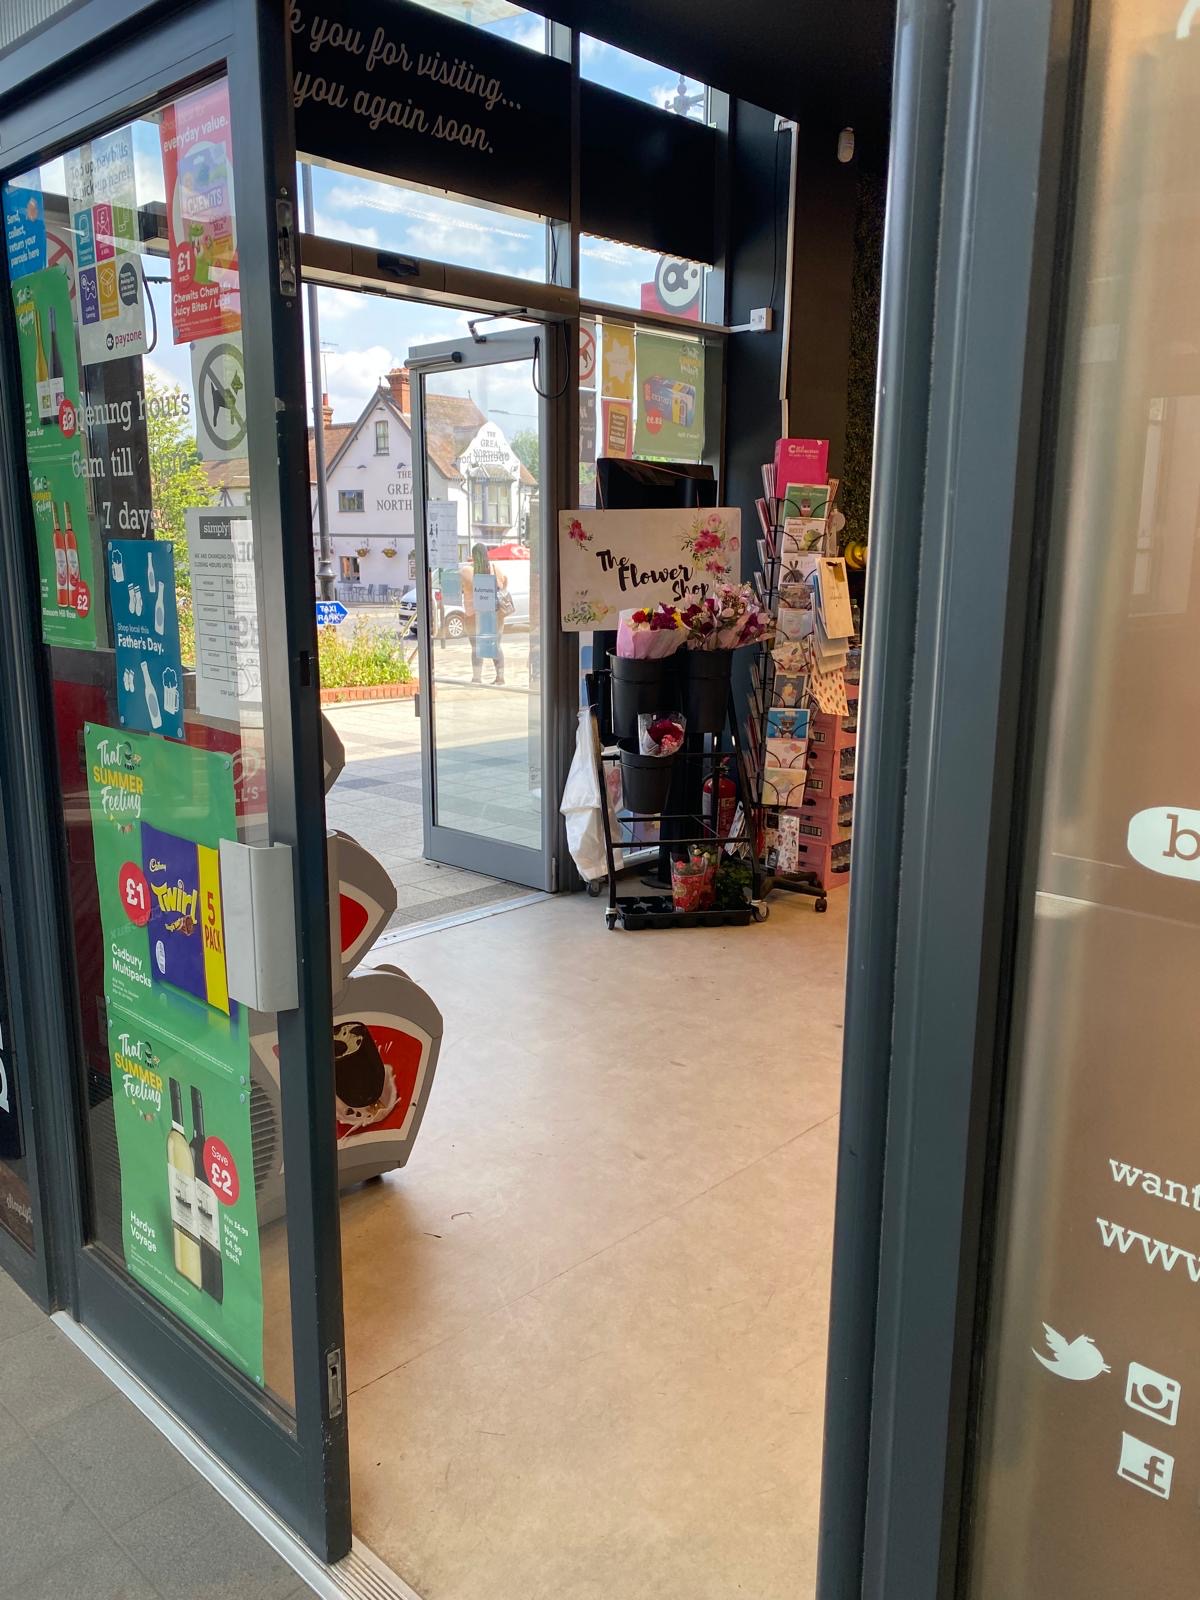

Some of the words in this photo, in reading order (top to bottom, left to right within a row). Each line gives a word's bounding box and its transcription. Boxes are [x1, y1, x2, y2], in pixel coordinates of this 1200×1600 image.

[310, 16, 365, 53] you
[366, 27, 413, 72] for
[417, 52, 522, 111] visiting...
[293, 71, 348, 108] you
[353, 90, 429, 130] again
[431, 114, 494, 153] soon.
[164, 126, 200, 150] everyday
[201, 115, 229, 136] value.
[187, 188, 223, 213] CHEWITS
[177, 250, 191, 273] £1
[173, 289, 199, 304] Chewits
[200, 286, 219, 299] Chew
[173, 305, 190, 317] Juicy
[191, 302, 208, 313] Bites
[115, 329, 142, 349] payzone
[137, 391, 190, 419] hours
[72, 450, 106, 478] 6am
[111, 448, 133, 476] till
[397, 471, 412, 479] THE
[102, 501, 111, 529] 7
[118, 501, 158, 538] days
[596, 549, 630, 572] The
[618, 563, 694, 592] Flower
[672, 578, 709, 602] Shop
[77, 594, 89, 611] £2
[320, 605, 337, 613] TAXI
[117, 622, 129, 633] Shop
[129, 624, 140, 634] local
[140, 625, 150, 635] this
[117, 633, 146, 650] Father's
[147, 637, 164, 656] Day.
[97, 739, 123, 767] That
[93, 766, 144, 795] SUMMER
[101, 785, 142, 818] Feeling
[126, 878, 145, 910] £1
[151, 879, 197, 925] Twirl
[207, 891, 216, 926] 5
[204, 926, 222, 954] PACK
[112, 943, 142, 971] Cadbury
[112, 959, 152, 988] Multipacks
[118, 1034, 144, 1061] That
[114, 1052, 163, 1091] SUMMER
[122, 1074, 161, 1112] Feeling
[211, 1146, 229, 1166] Save
[211, 1164, 233, 1197] £2
[130, 1210, 156, 1239] Hardys
[224, 1225, 238, 1243] Now
[130, 1225, 157, 1253] Voyage
[225, 1249, 241, 1266] each
